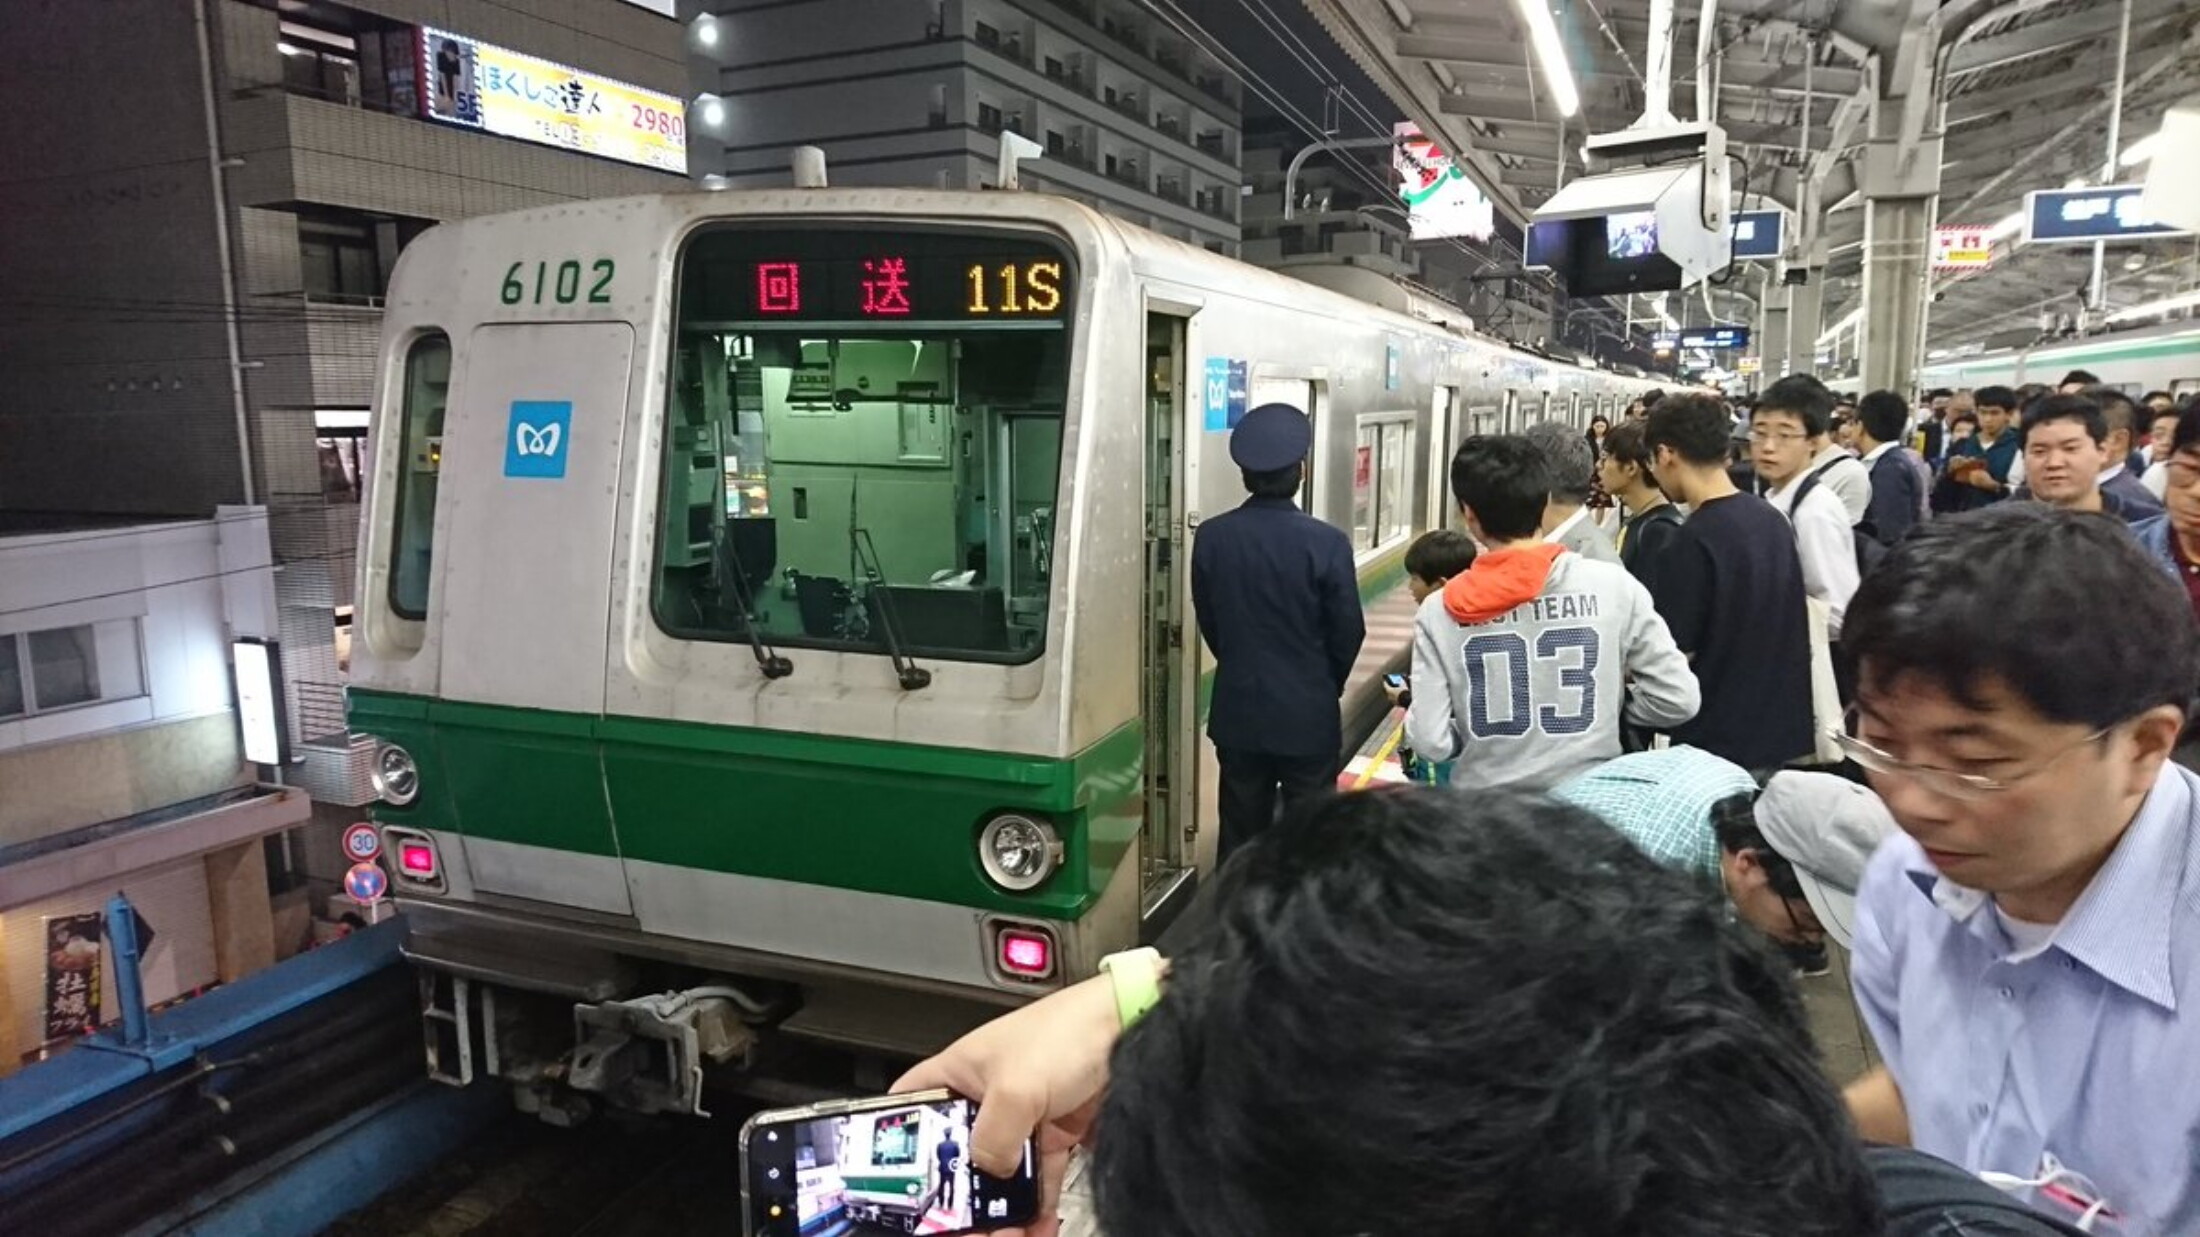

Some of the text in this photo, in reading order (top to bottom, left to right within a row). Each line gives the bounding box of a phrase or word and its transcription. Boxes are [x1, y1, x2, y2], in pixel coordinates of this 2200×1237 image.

[632, 104, 683, 136] 2980
[500, 259, 615, 305] 6102
[757, 258, 1061, 314] 回送 11S
[1530, 595, 1599, 621] TEAM
[1463, 626, 1600, 739] 03
[352, 833, 375, 851] 30
